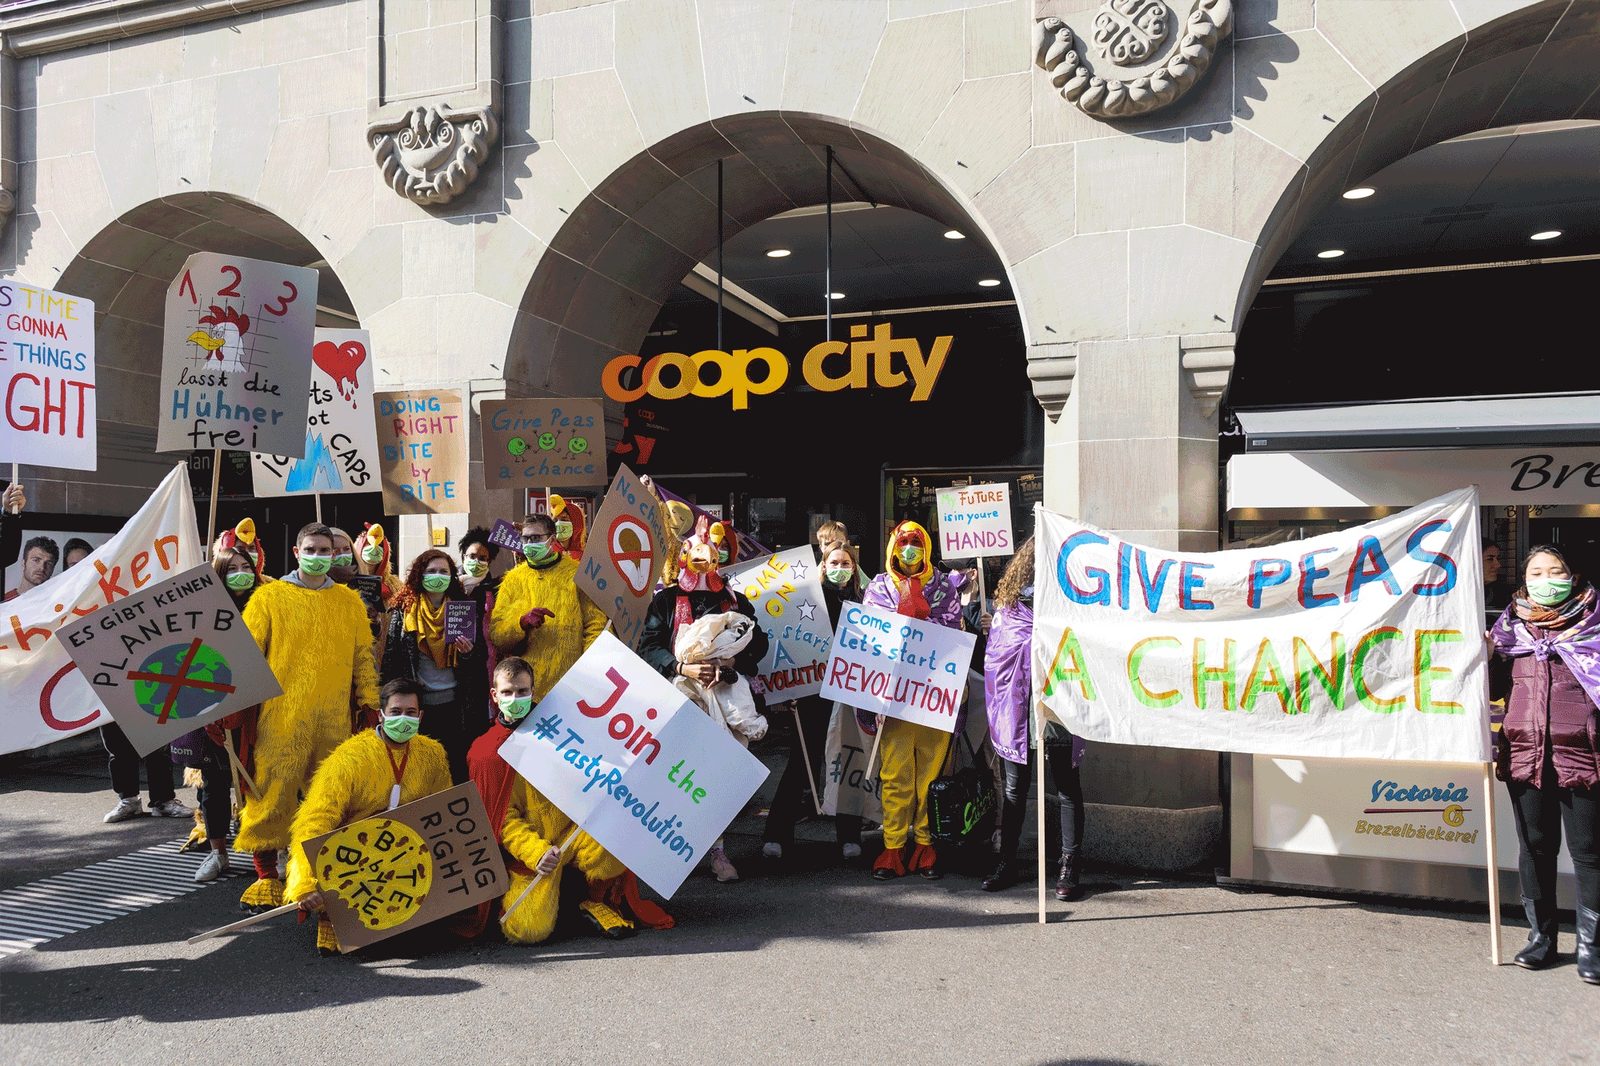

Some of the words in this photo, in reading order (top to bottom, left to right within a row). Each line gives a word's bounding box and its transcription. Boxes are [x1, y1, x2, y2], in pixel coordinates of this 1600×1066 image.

[217, 265, 242, 297] 2
[264, 280, 298, 316] 3
[7, 314, 68, 341] GONNA
[177, 367, 227, 387] lasst
[244, 372, 281, 396] die
[602, 347, 789, 411] coop
[802, 322, 954, 402] city
[172, 388, 283, 425] Hühner
[491, 408, 542, 432] Give
[551, 407, 594, 427] Peas
[188, 419, 259, 449] frei
[330, 433, 371, 487] CAPS
[499, 467, 512, 479] a
[524, 457, 594, 478] chance
[616, 475, 635, 505] No
[944, 513, 952, 522] is
[954, 512, 964, 521] in
[966, 510, 999, 525] youre
[946, 530, 1008, 551] HANDS
[584, 556, 607, 590] No
[744, 553, 789, 601] OME
[1057, 529, 1216, 613] GIVE
[1246, 518, 1458, 609] PEAS
[765, 581, 798, 618] ON
[69, 625, 95, 648] ES
[782, 623, 831, 653] start
[846, 607, 892, 633] Come
[900, 626, 924, 642] on
[93, 611, 203, 687] PLANET
[213, 609, 235, 631] B
[772, 639, 796, 669] A
[887, 641, 936, 670] start
[945, 662, 956, 675] a
[1042, 625, 1097, 701] A
[1127, 625, 1465, 714] CHANCE
[576, 666, 661, 765] Join
[667, 759, 708, 804] the
[1371, 780, 1469, 802] Victoria
[1355, 820, 1479, 844] Brezelbäckerei
